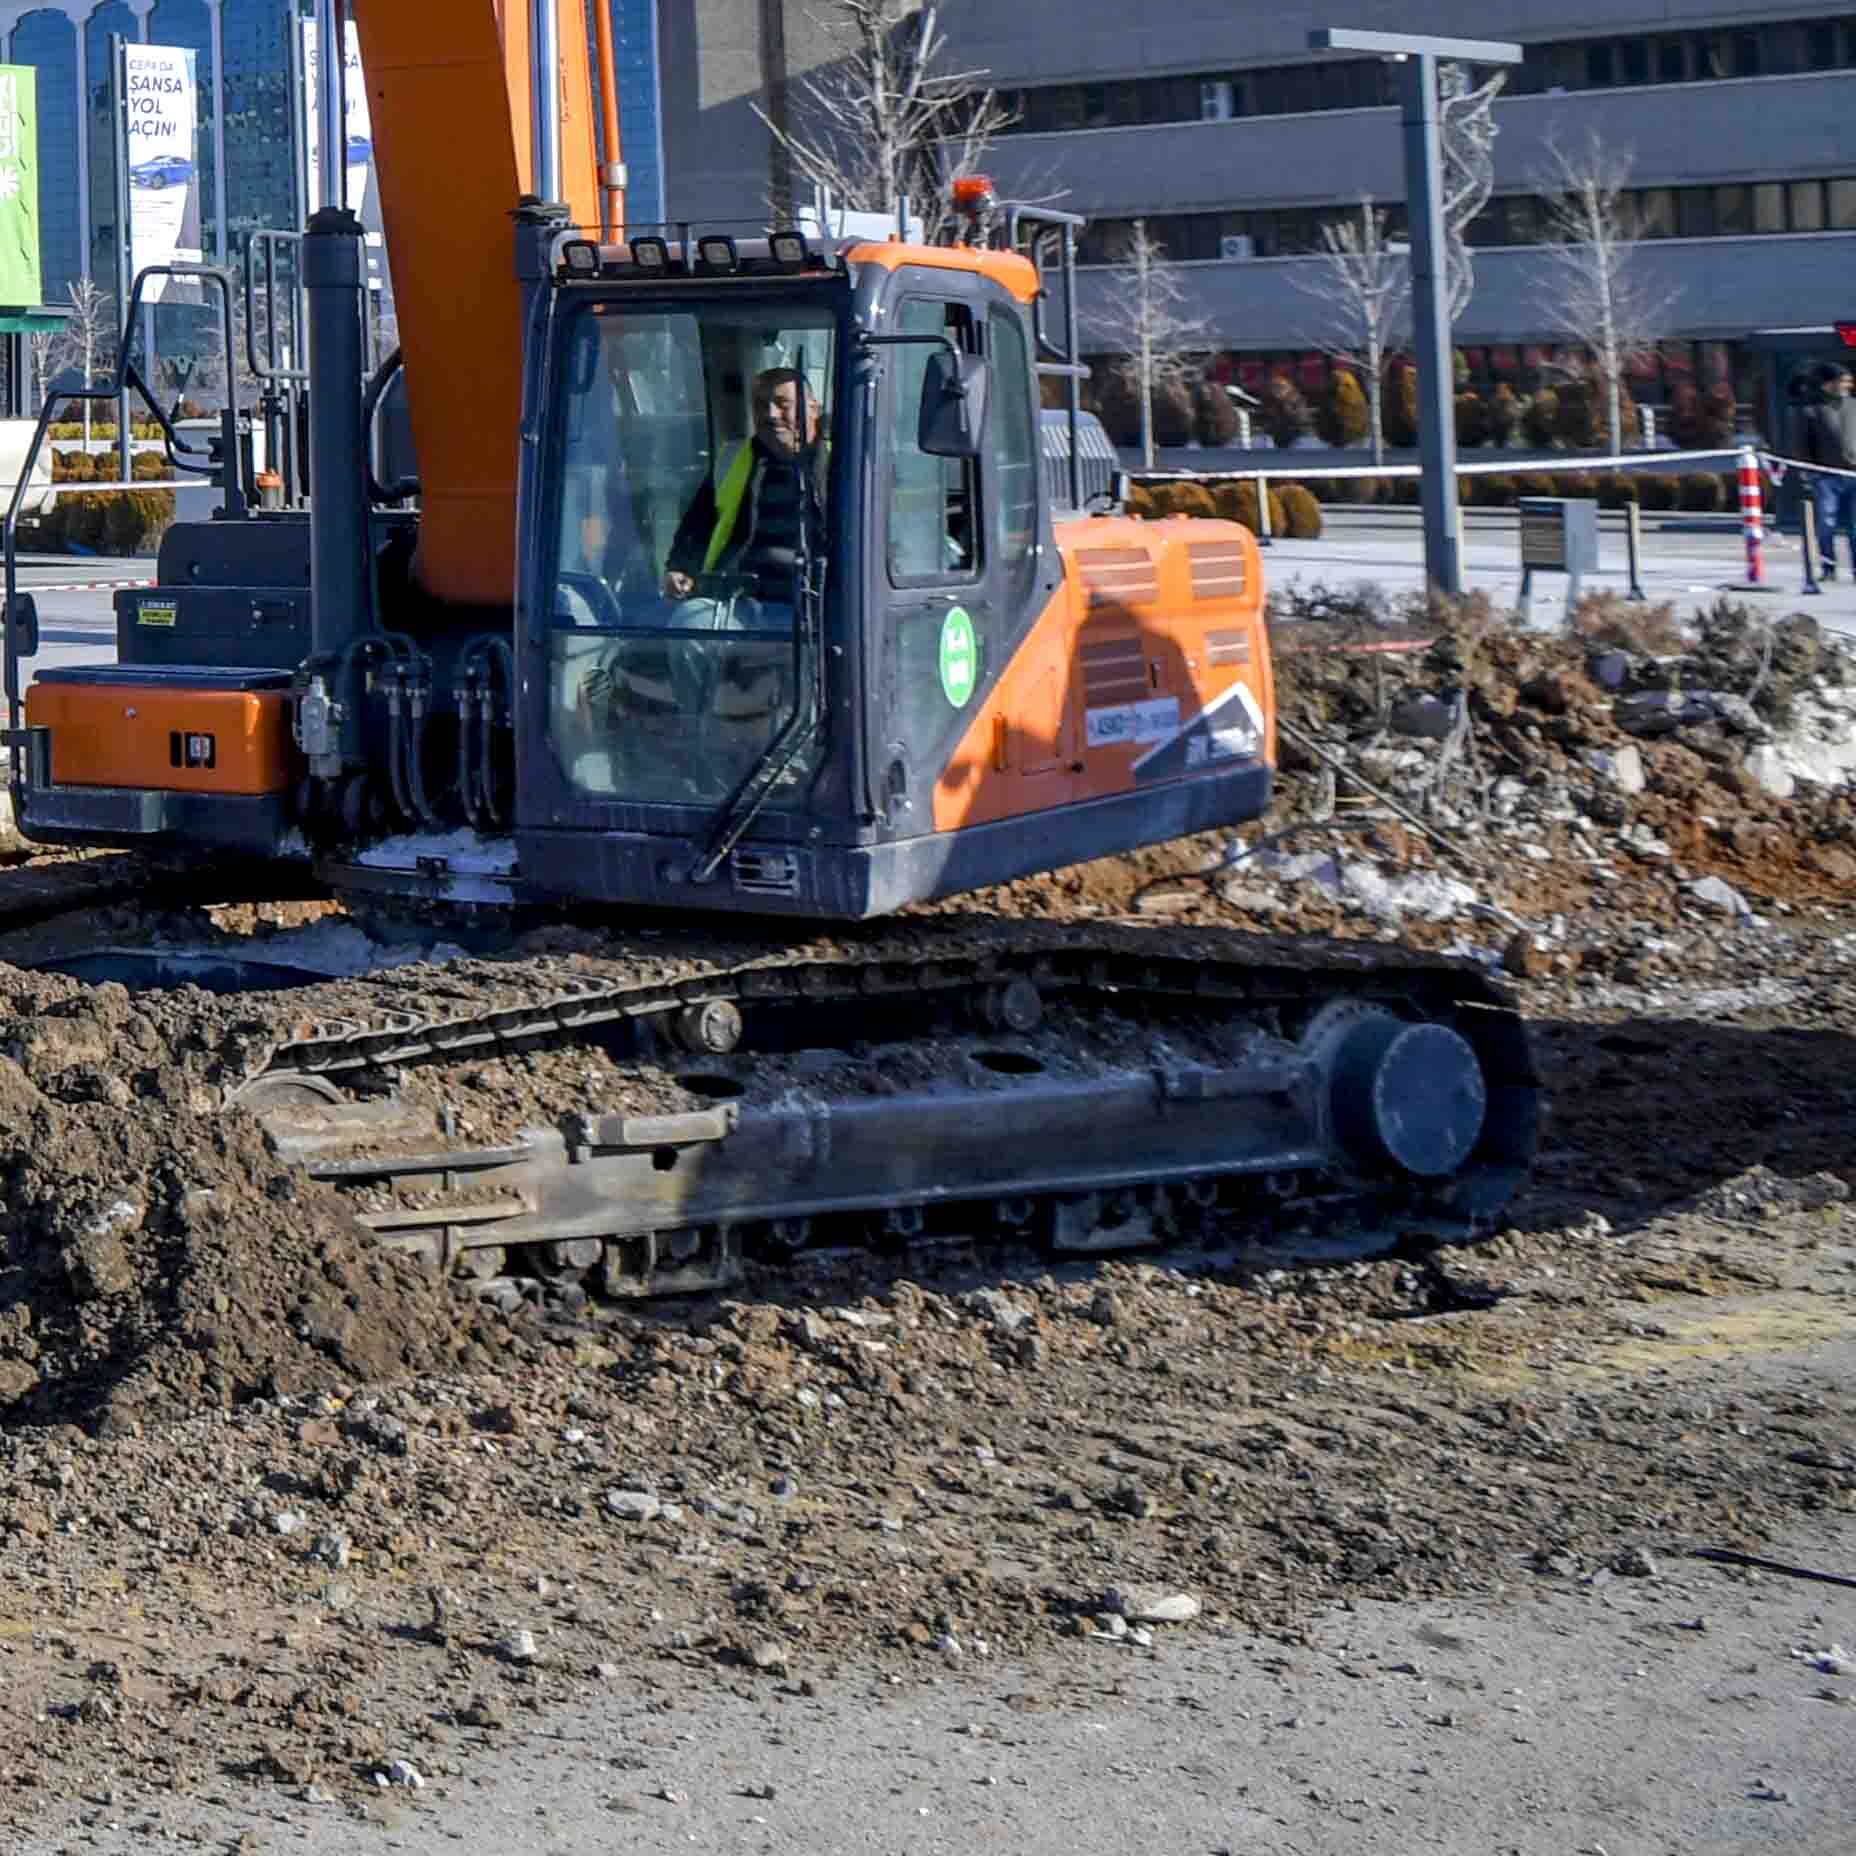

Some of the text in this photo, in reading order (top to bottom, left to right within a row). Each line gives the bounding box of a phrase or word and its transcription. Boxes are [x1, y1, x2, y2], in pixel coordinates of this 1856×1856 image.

[129, 75, 183, 95] ŞANSA
[130, 97, 164, 114] YOL
[129, 119, 177, 142] AÇIN!
